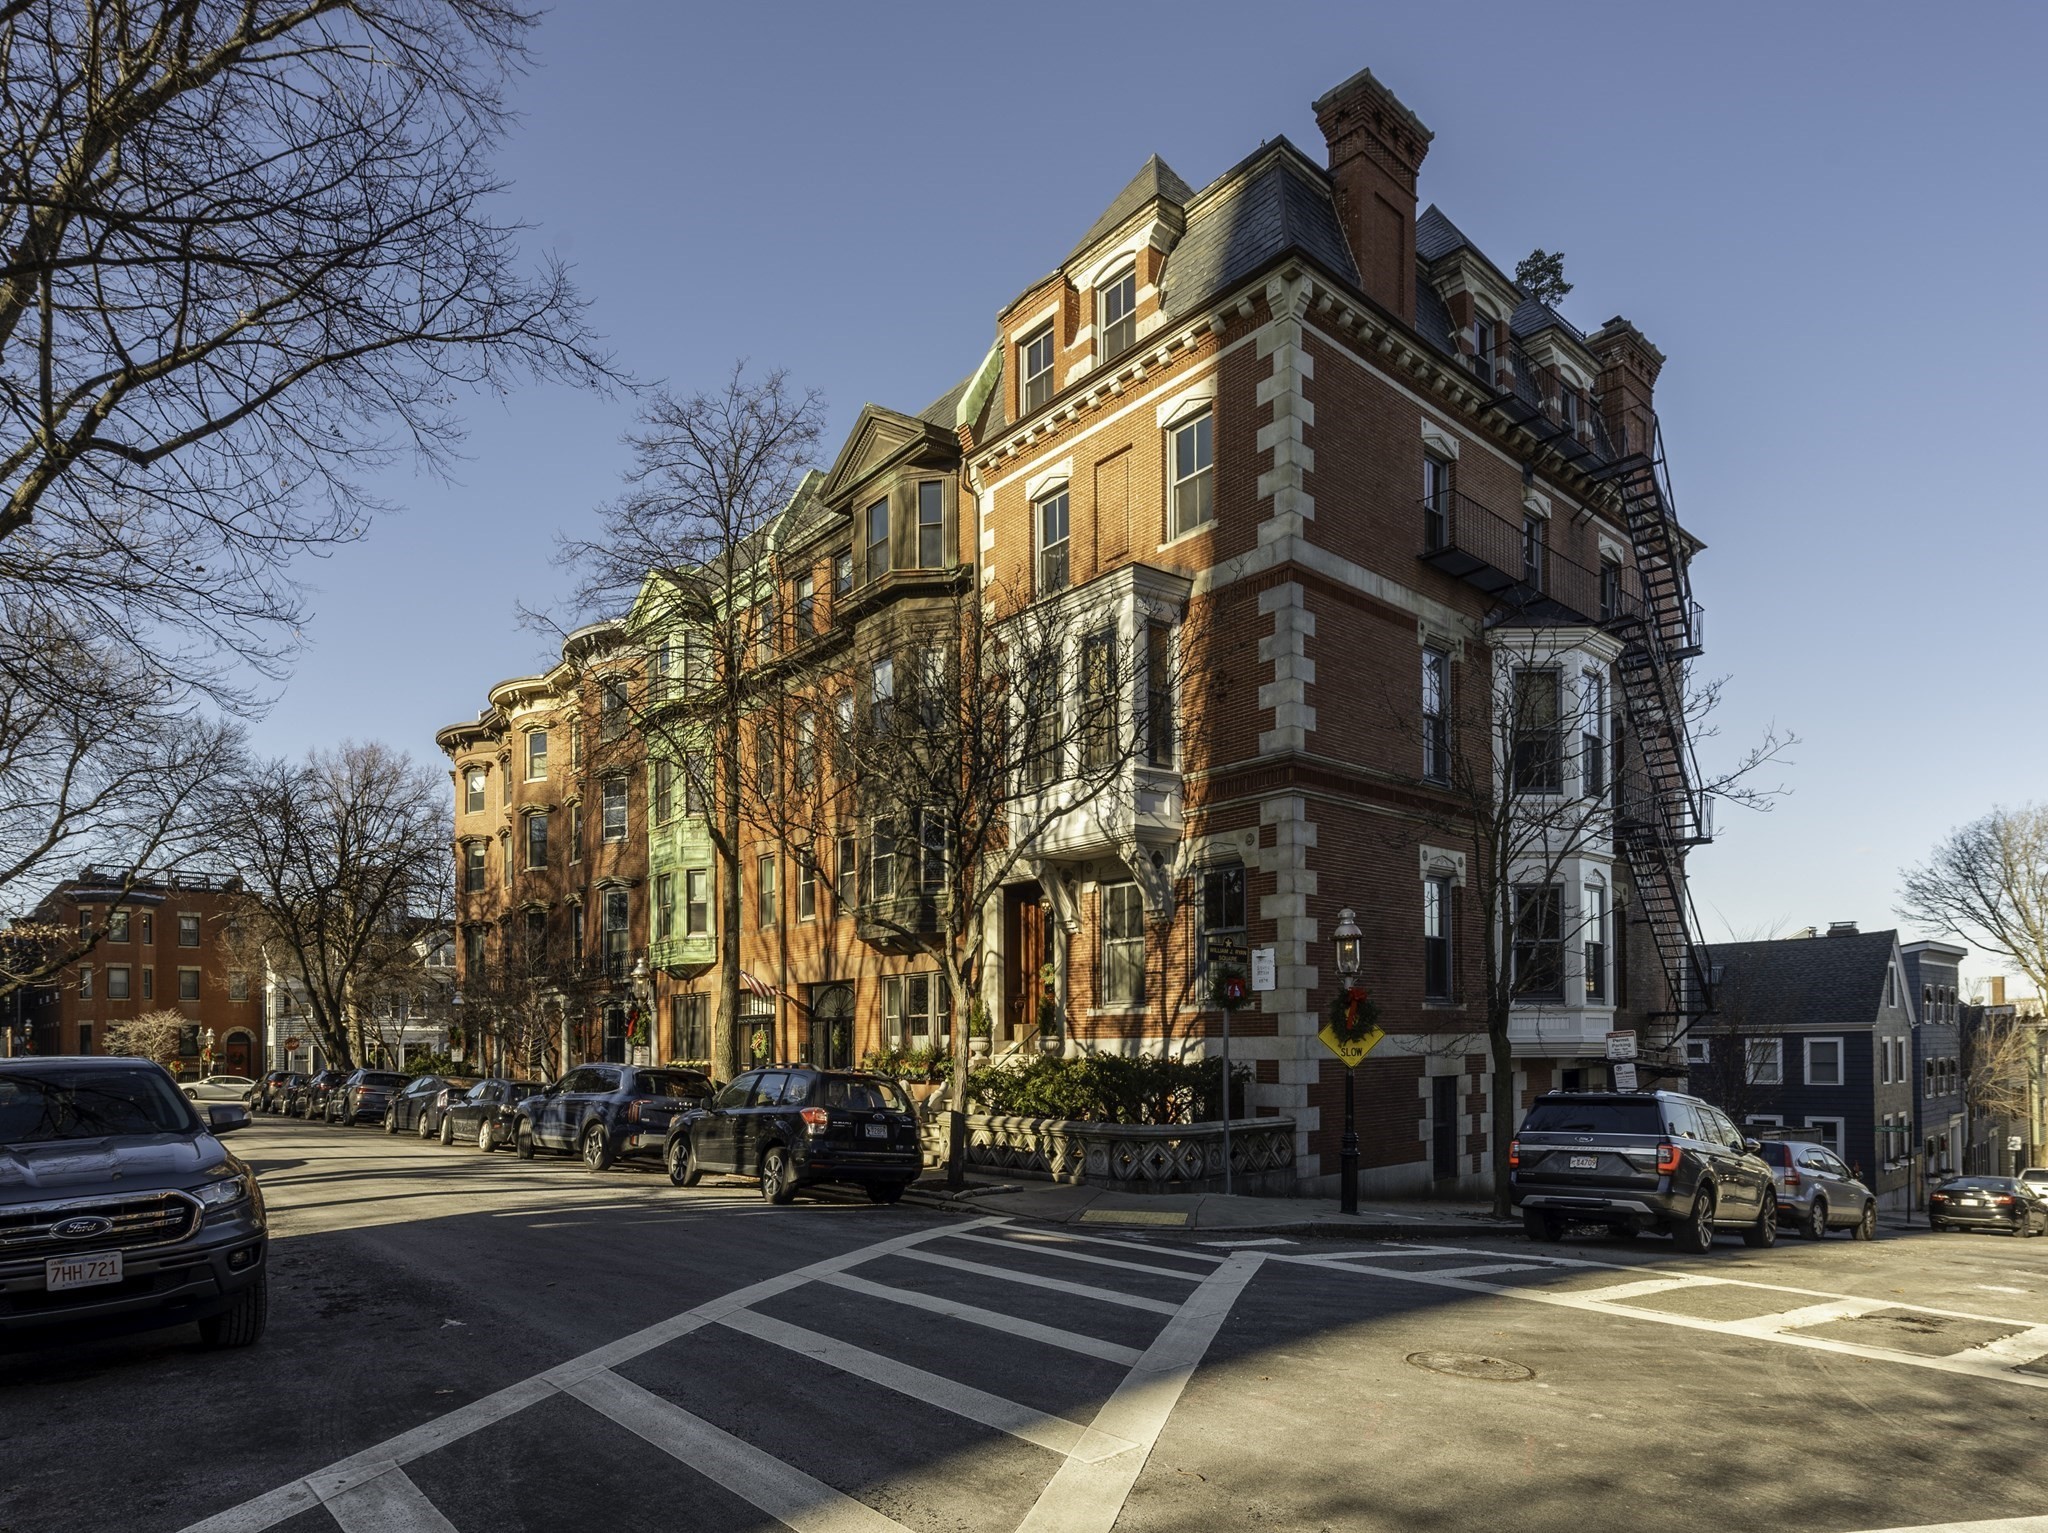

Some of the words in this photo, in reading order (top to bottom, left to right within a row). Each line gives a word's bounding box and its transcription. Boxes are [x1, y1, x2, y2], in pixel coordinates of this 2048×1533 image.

[1340, 1047, 1363, 1057] SLOW
[66, 1221, 97, 1233] Ford
[51, 1264, 82, 1283] 7HH
[87, 1260, 119, 1279] 721
